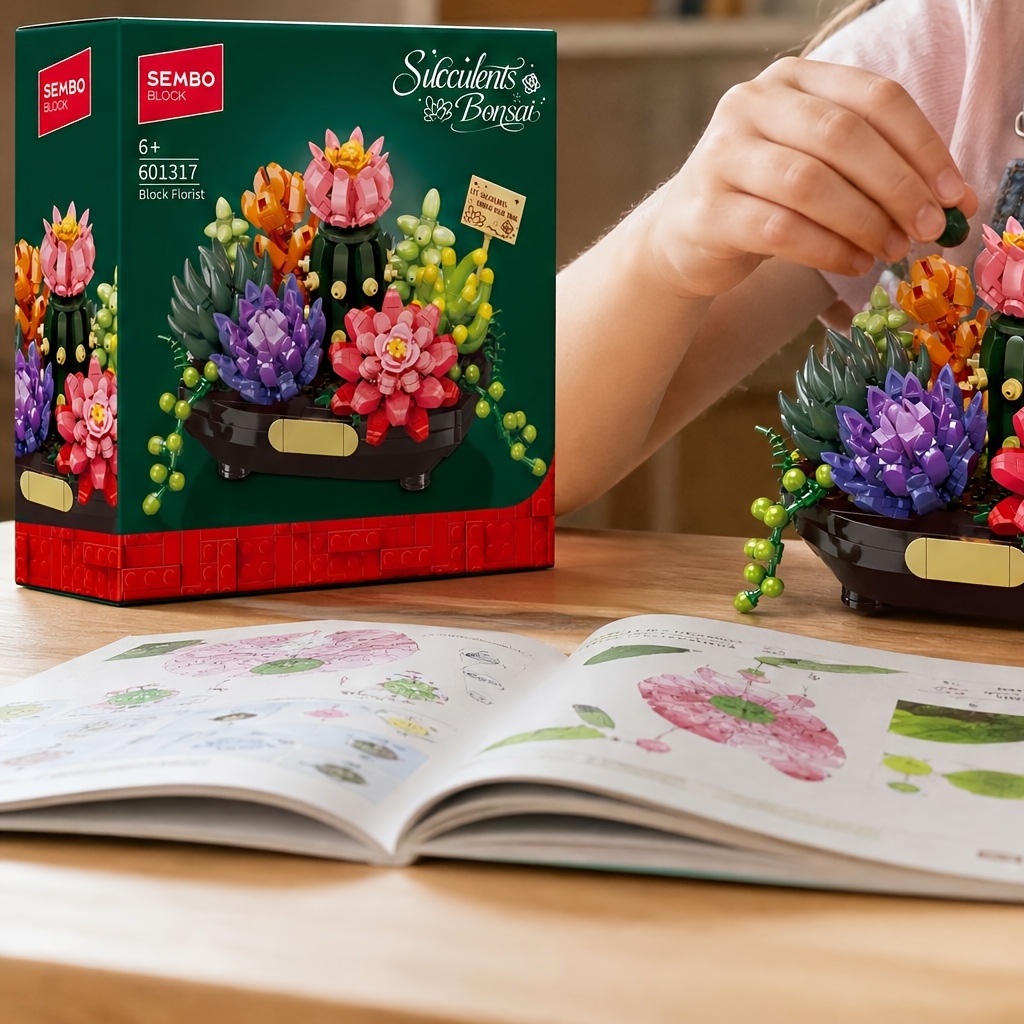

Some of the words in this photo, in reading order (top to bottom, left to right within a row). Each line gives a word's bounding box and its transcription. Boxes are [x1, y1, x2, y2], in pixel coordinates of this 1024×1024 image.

[147, 71, 216, 87] SEMBO
[392, 49, 525, 96] Succulents
[43, 78, 86, 98] SEMBO
[147, 90, 187, 101] BLOCK
[43, 100, 68, 113] BLOCK
[451, 92, 541, 133] Bonsai
[138, 139, 161, 155] 6+
[138, 164, 198, 180] 601317
[139, 189, 169, 200] Block
[171, 189, 205, 200] Florist
